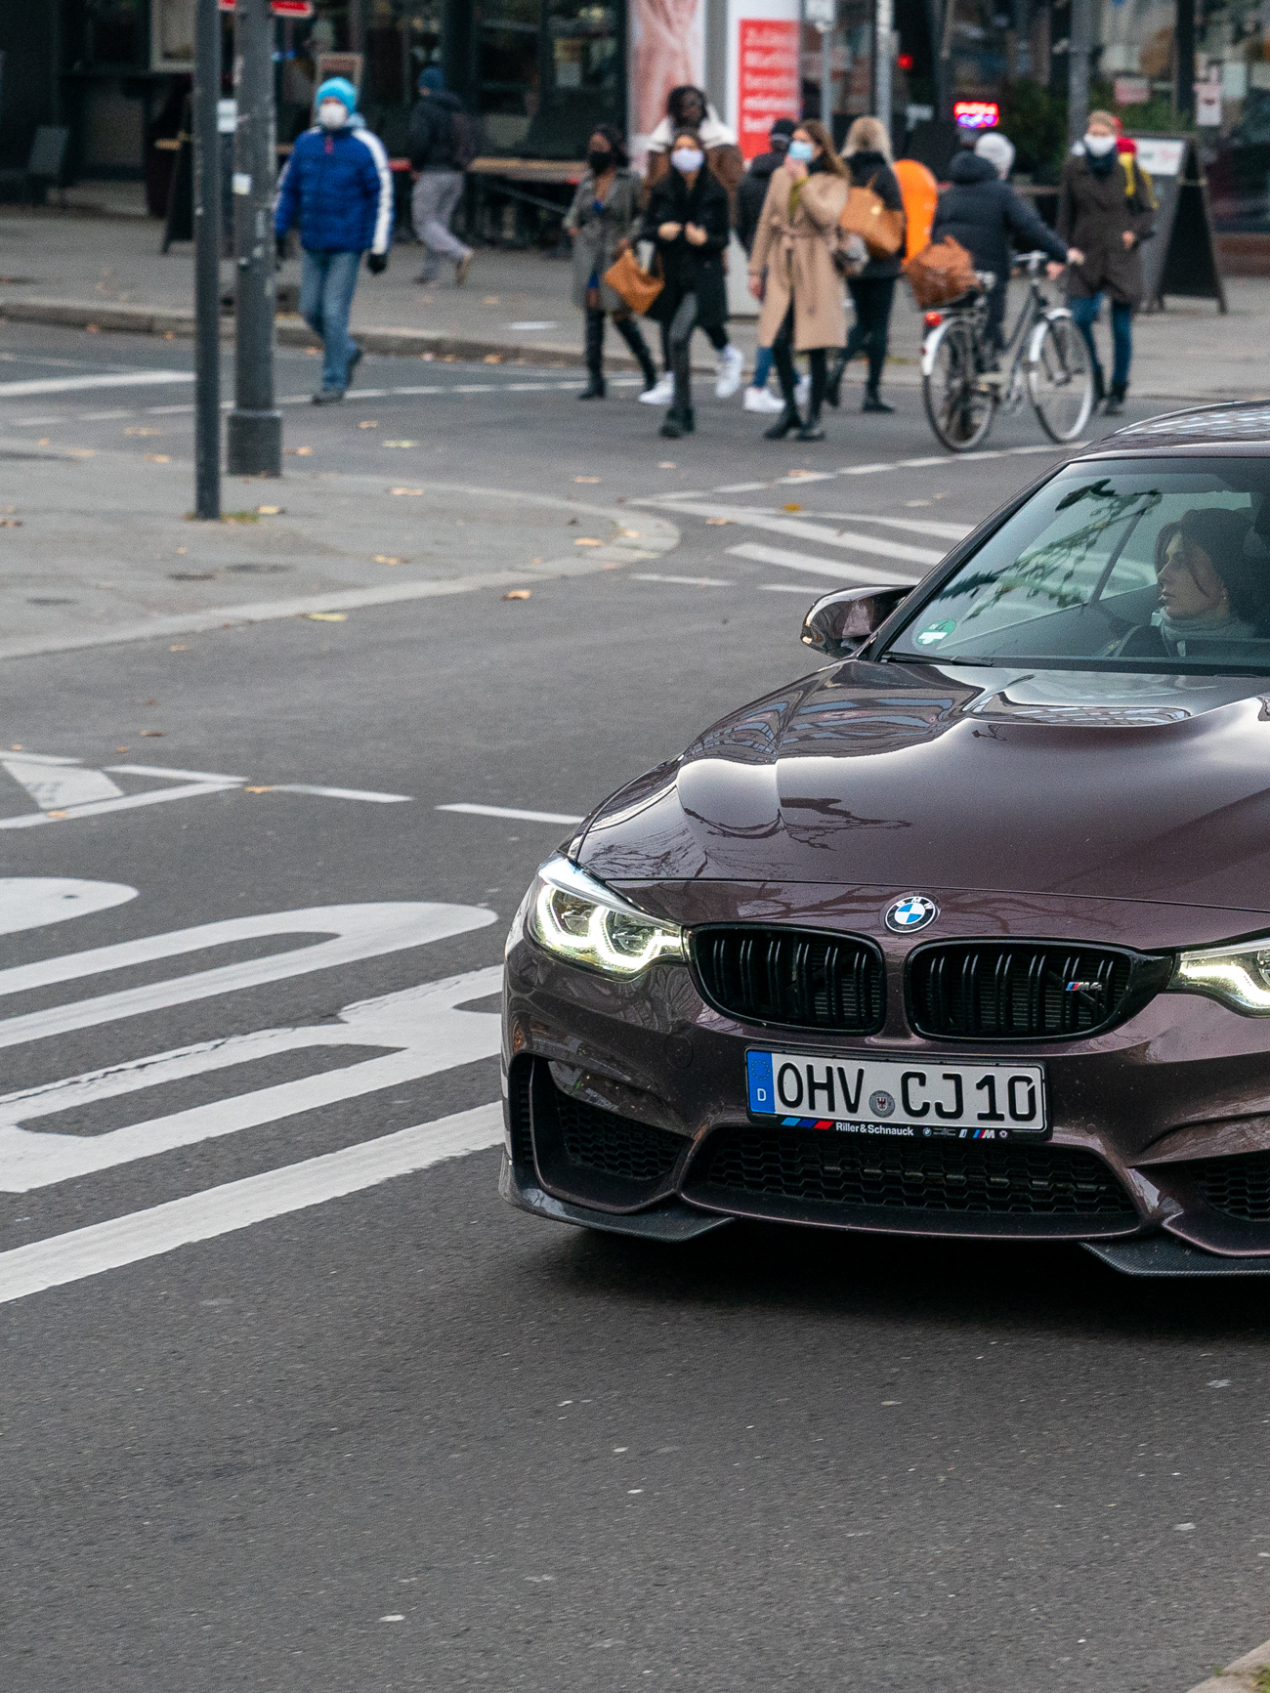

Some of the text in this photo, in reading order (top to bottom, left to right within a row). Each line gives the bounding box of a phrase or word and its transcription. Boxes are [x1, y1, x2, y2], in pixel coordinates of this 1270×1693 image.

[935, 620, 949, 632] 4
[757, 1088, 766, 1102] D
[777, 1062, 865, 1114] OHV
